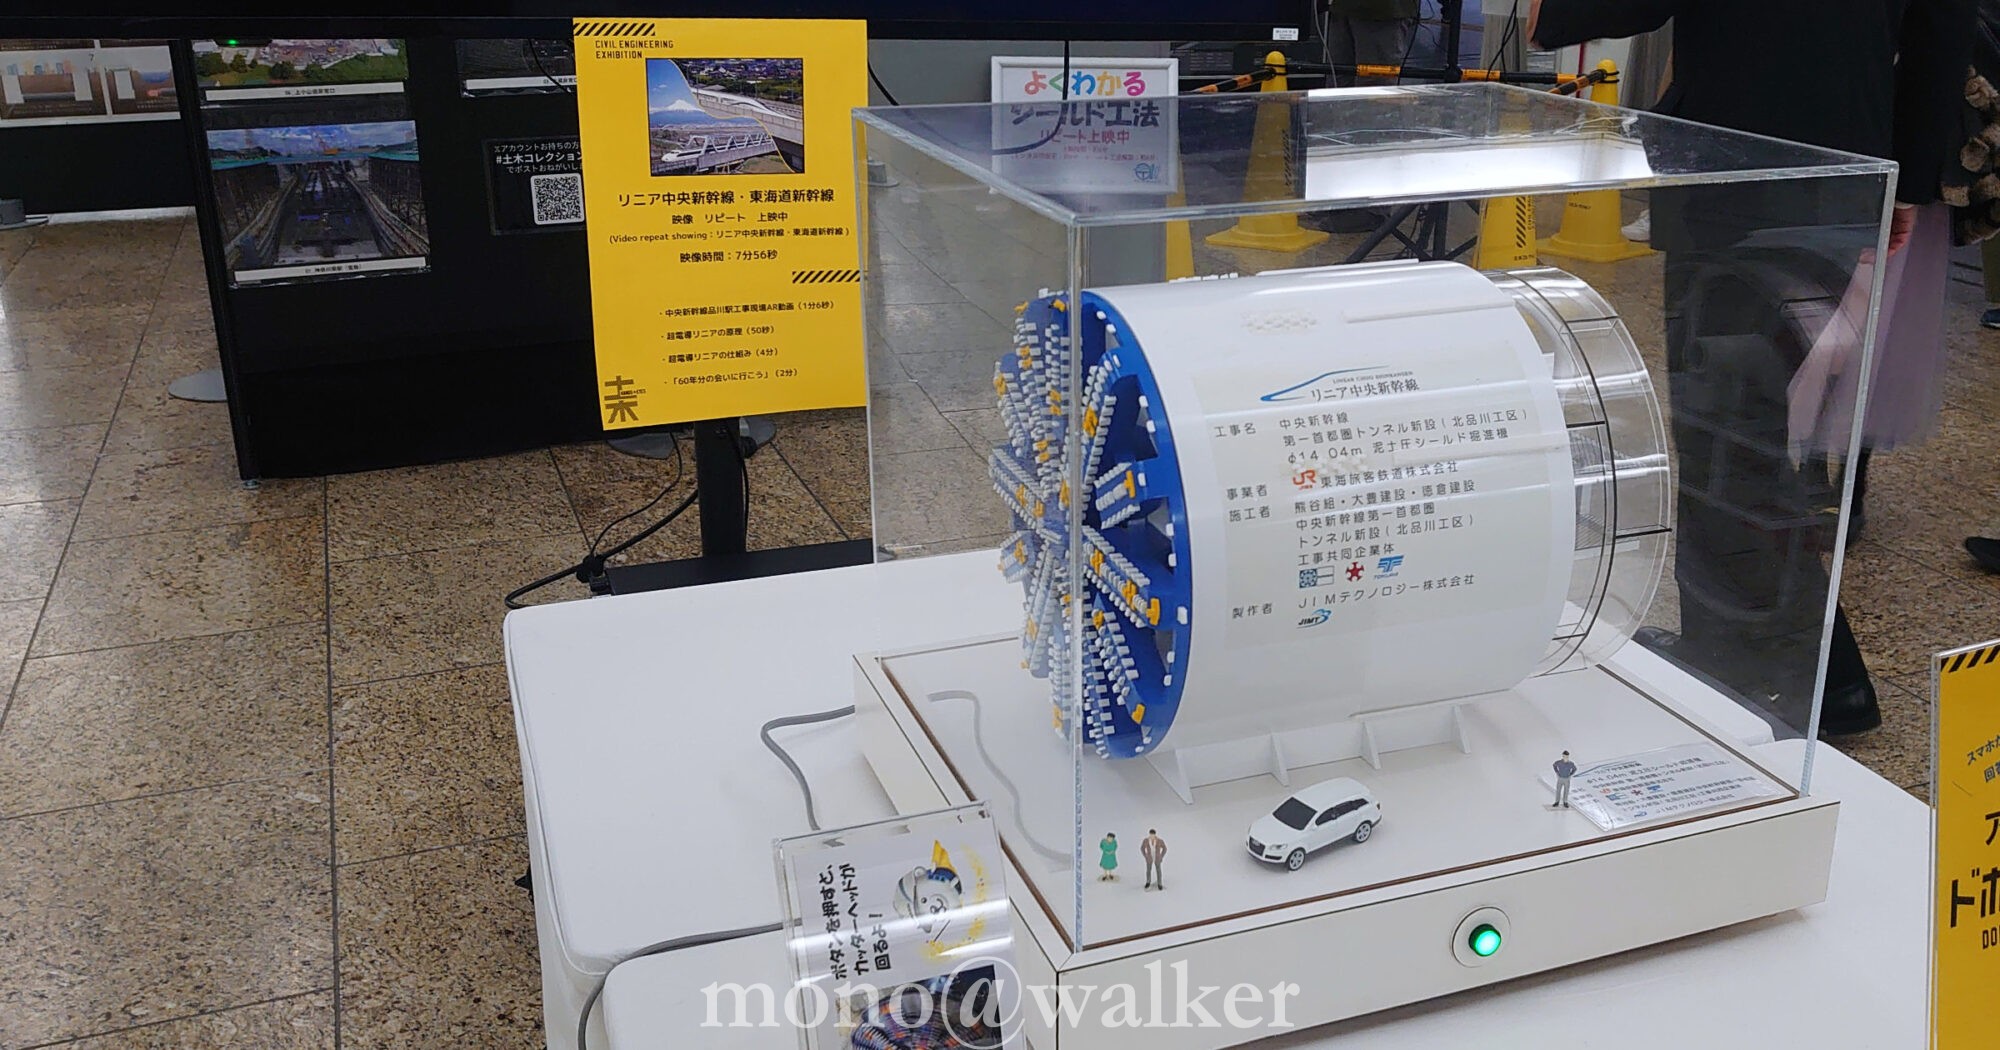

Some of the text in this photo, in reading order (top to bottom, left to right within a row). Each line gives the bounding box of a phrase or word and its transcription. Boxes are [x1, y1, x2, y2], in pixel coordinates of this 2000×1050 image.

[595, 40, 674, 49] CIVIL ENGINEERING
[596, 51, 642, 59] EXHIBITION
[1024, 70, 1146, 96] よくわかる
[506, 162, 582, 173] でポストおねがいし
[618, 188, 835, 207] リニア中央新幹線・東海道新幹線
[671, 212, 788, 225] 映像 リピート 上映中
[640, 233, 669, 243] repeat
[680, 249, 778, 263] 映像時間：7分56秒
[1310, 378, 1420, 402] リニア中央新幹線
[1214, 411, 1349, 438] 工事名 中央新幹線
[1226, 484, 1268, 500] 事業者
[1292, 469, 1317, 485] JR
[1229, 505, 1271, 523] 施工者
[1296, 502, 1436, 531] 中央新幹線第一首都圏
[1298, 543, 1395, 567] 工事共同企業体
[1232, 603, 1273, 619] 製作者
[1298, 616, 1320, 626] JIMT
